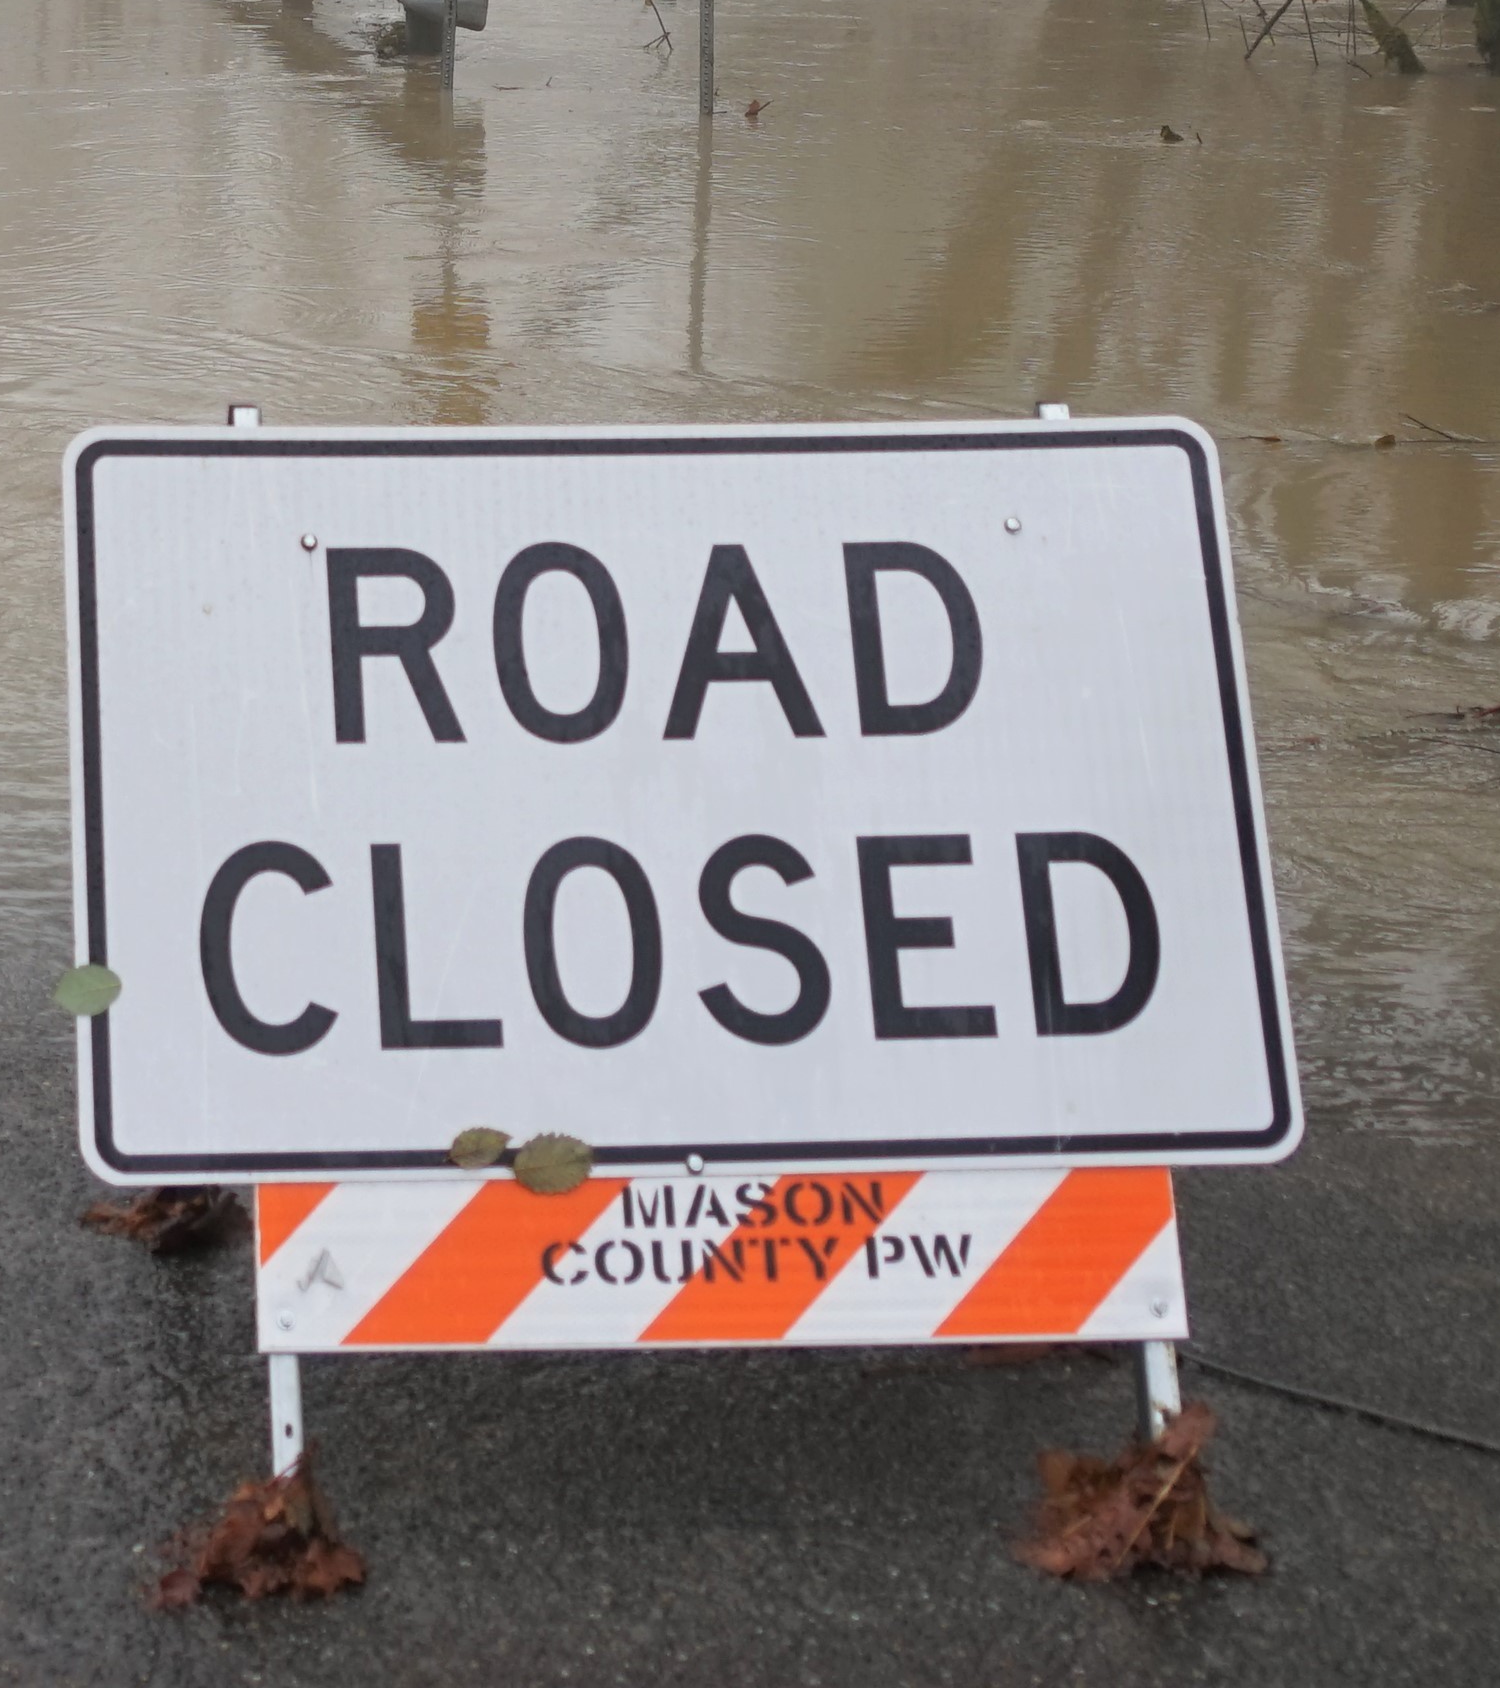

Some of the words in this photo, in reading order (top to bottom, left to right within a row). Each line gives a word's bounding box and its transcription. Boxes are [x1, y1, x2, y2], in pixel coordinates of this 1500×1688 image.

[326, 542, 982, 744] ROAD
[200, 832, 1160, 1056] CLOSED
[542, 1237, 837, 1285] COUNTY
[866, 1235, 970, 1278] PW
[622, 1182, 882, 1228] MASON
